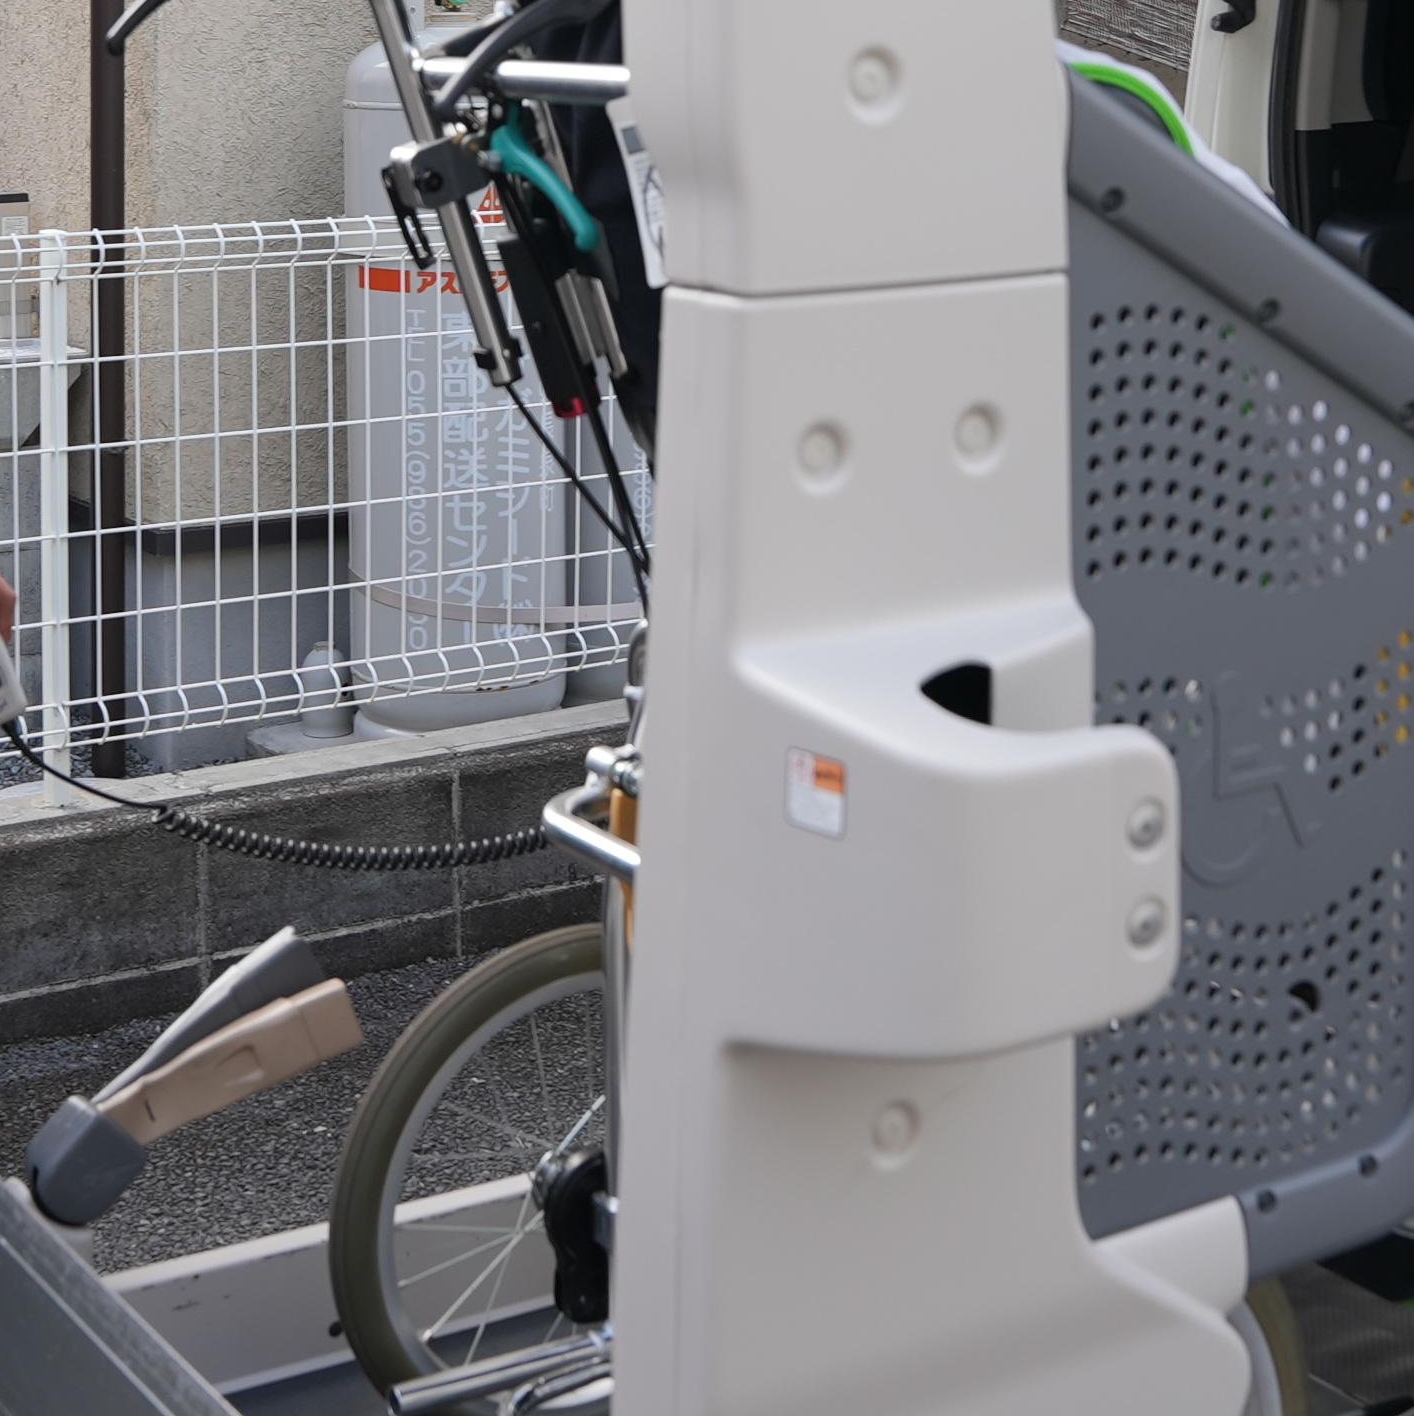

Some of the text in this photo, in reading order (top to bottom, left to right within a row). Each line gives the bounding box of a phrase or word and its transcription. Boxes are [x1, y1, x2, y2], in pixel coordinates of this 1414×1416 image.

[405, 370, 432, 650] 055(986)200
[441, 311, 490, 646] 東部配送センター
